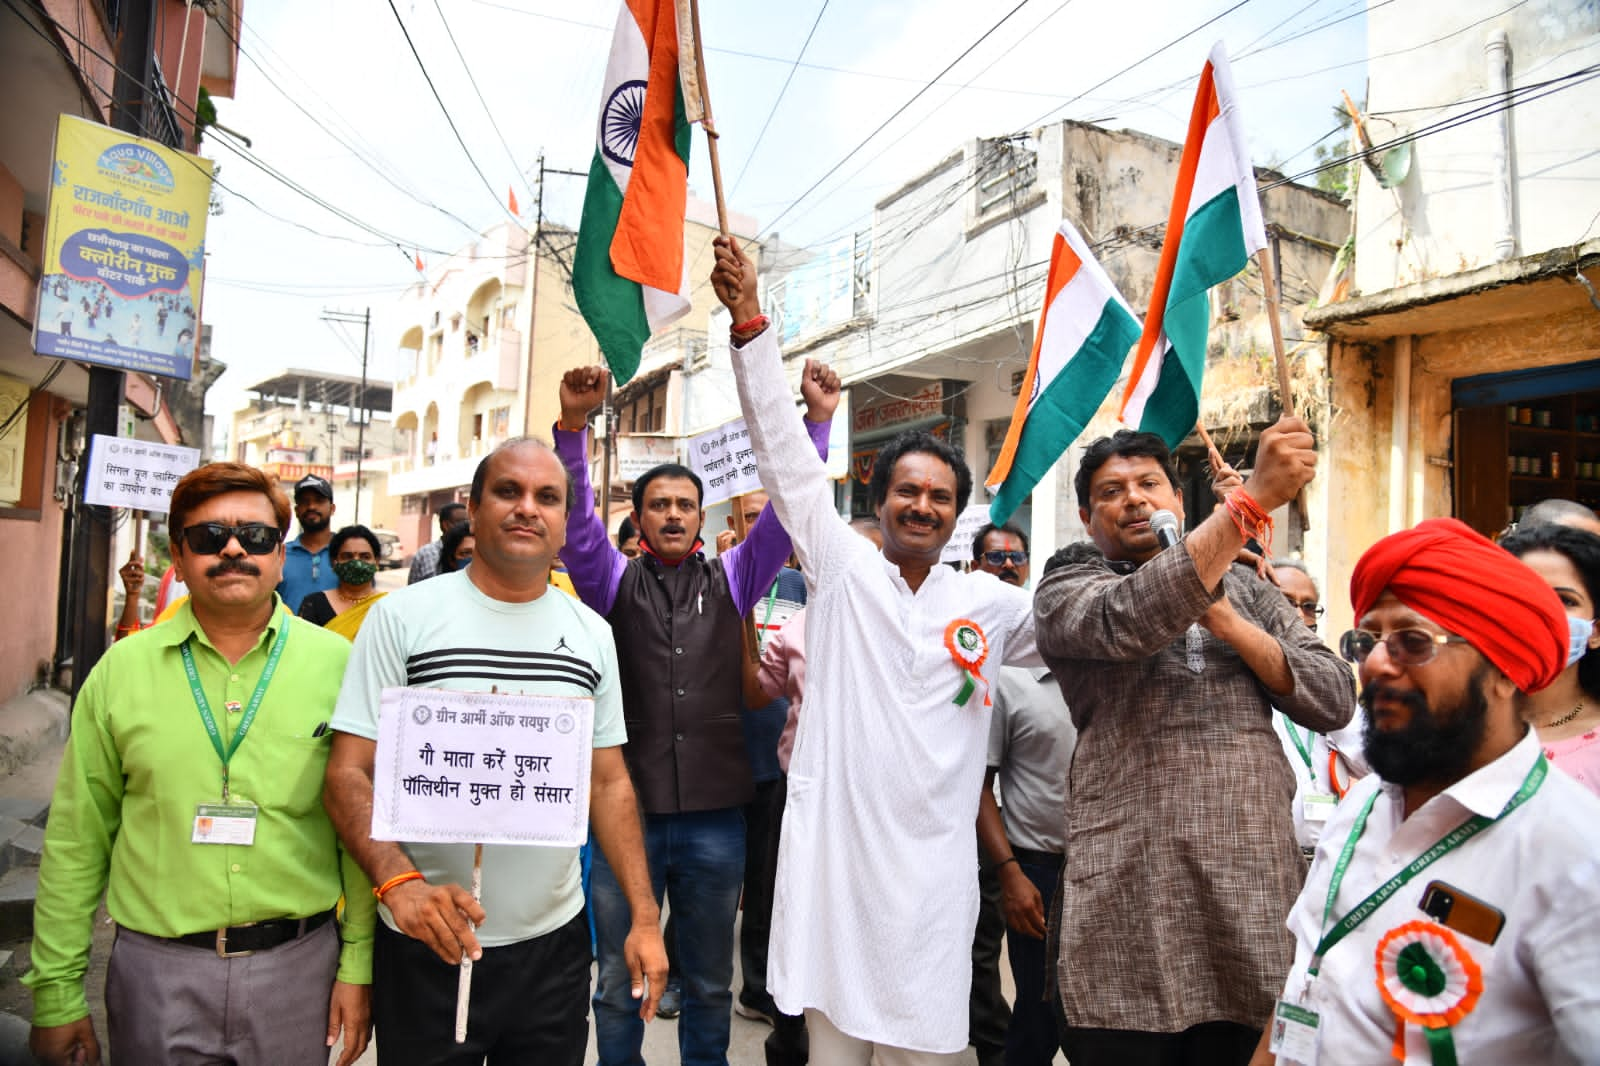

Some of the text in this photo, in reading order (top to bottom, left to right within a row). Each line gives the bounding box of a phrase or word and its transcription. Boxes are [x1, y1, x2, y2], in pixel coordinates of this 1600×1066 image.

[157, 207, 190, 228] आओ
[78, 245, 178, 283] क्लोरीन मुक्त
[726, 451, 732, 462] के
[103, 481, 115, 492] का
[436, 706, 551, 733] ग्रीन आर्मी ऑफ रायपुर
[419, 742, 553, 778] गौ माता करें पुकार
[402, 774, 574, 806] पॉलिथीन मुक्त हो संसार
[1410, 823, 1479, 873] GREEN ARMY
[1343, 877, 1403, 930] GREEN ARMY
